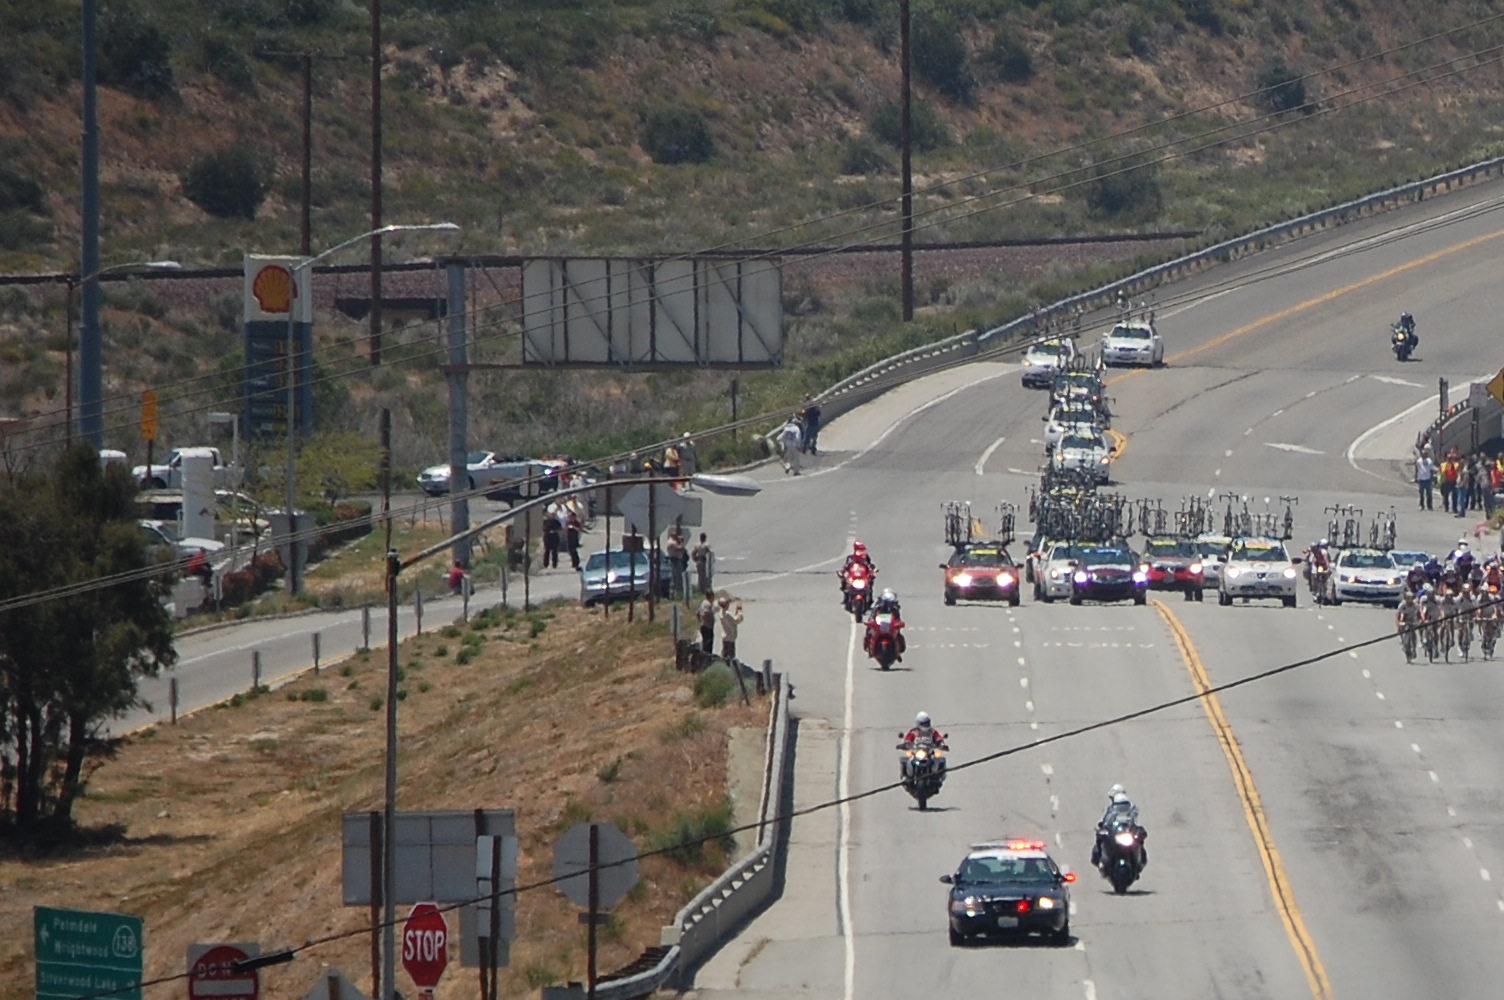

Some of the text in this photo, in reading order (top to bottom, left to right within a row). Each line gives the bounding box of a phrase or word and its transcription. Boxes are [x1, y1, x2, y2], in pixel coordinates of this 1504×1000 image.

[53, 917, 98, 934] Palmdale
[54, 940, 109, 959] Wrightwood
[116, 935, 137, 953] 138
[404, 928, 445, 962] STOP
[40, 970, 117, 991] Silverwood Lake
